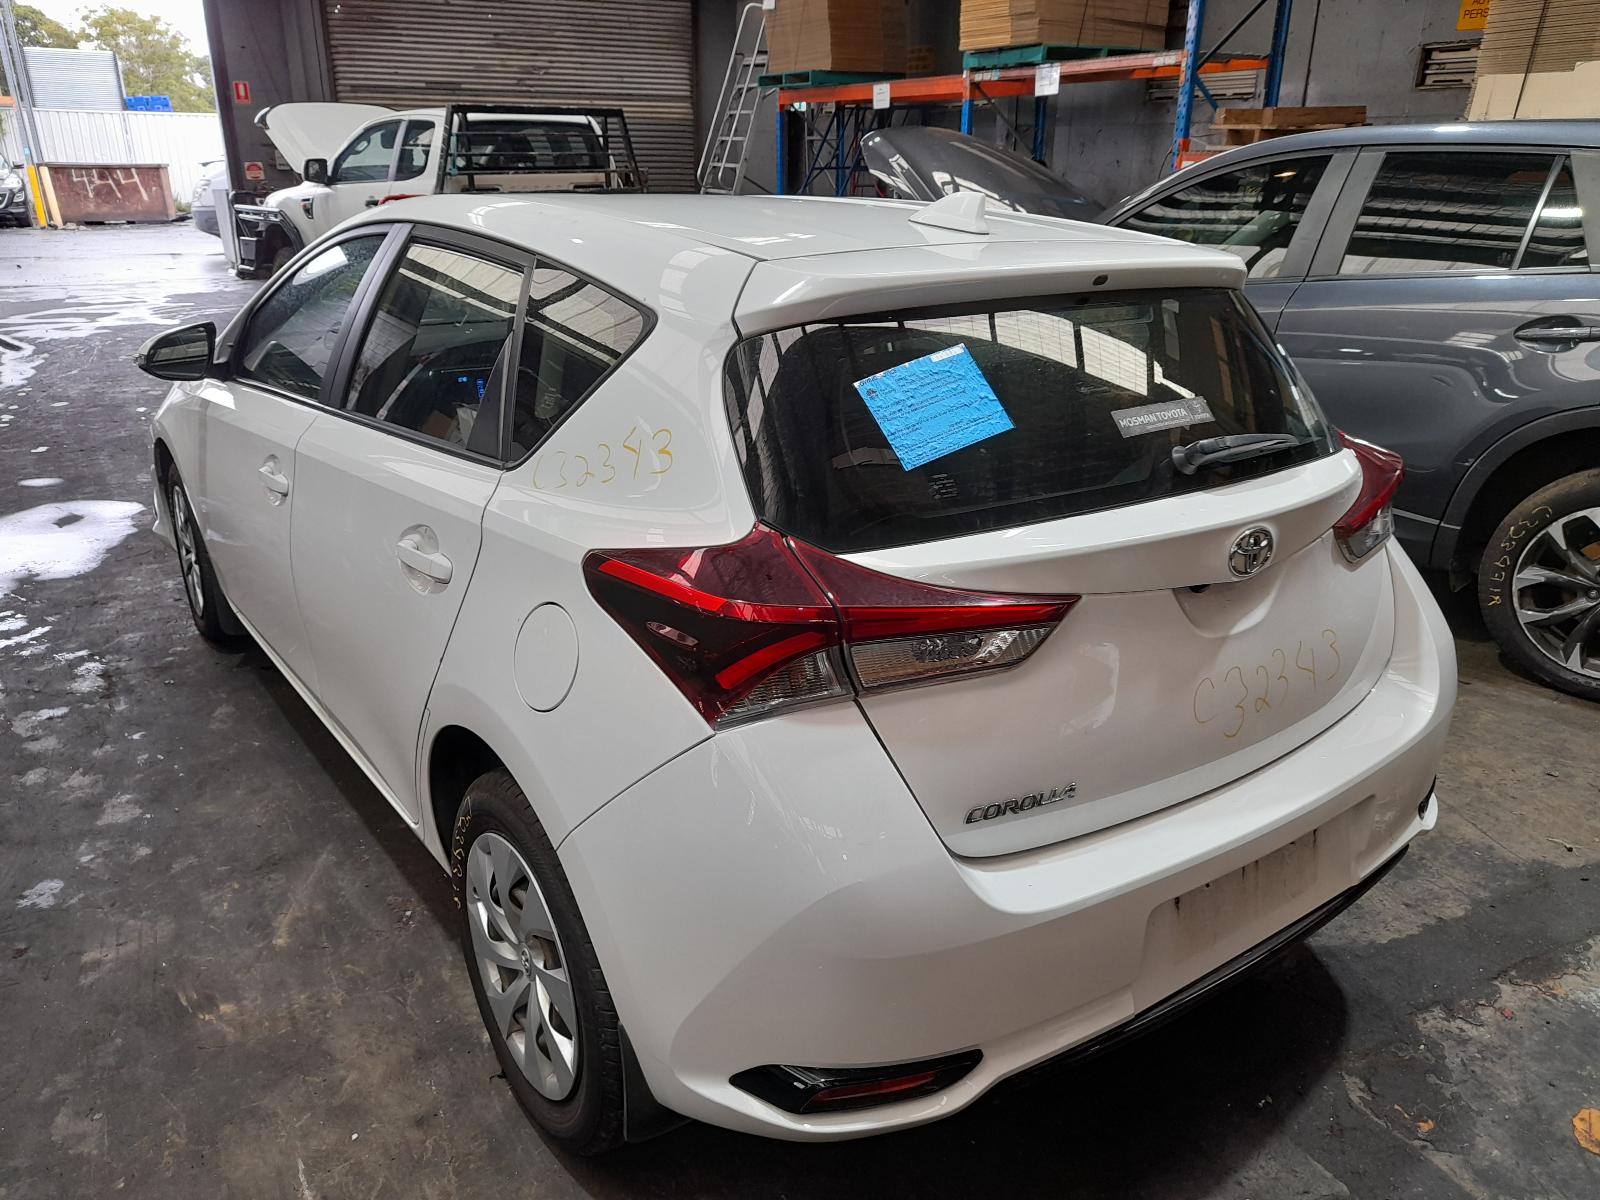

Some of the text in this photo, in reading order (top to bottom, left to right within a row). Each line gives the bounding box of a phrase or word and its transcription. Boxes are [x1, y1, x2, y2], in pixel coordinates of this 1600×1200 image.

[1119, 412, 1157, 428] MOSMAN
[1155, 407, 1188, 421] TOYOTA
[1193, 628, 1342, 739] C32343
[963, 781, 1077, 825] COROLLA
